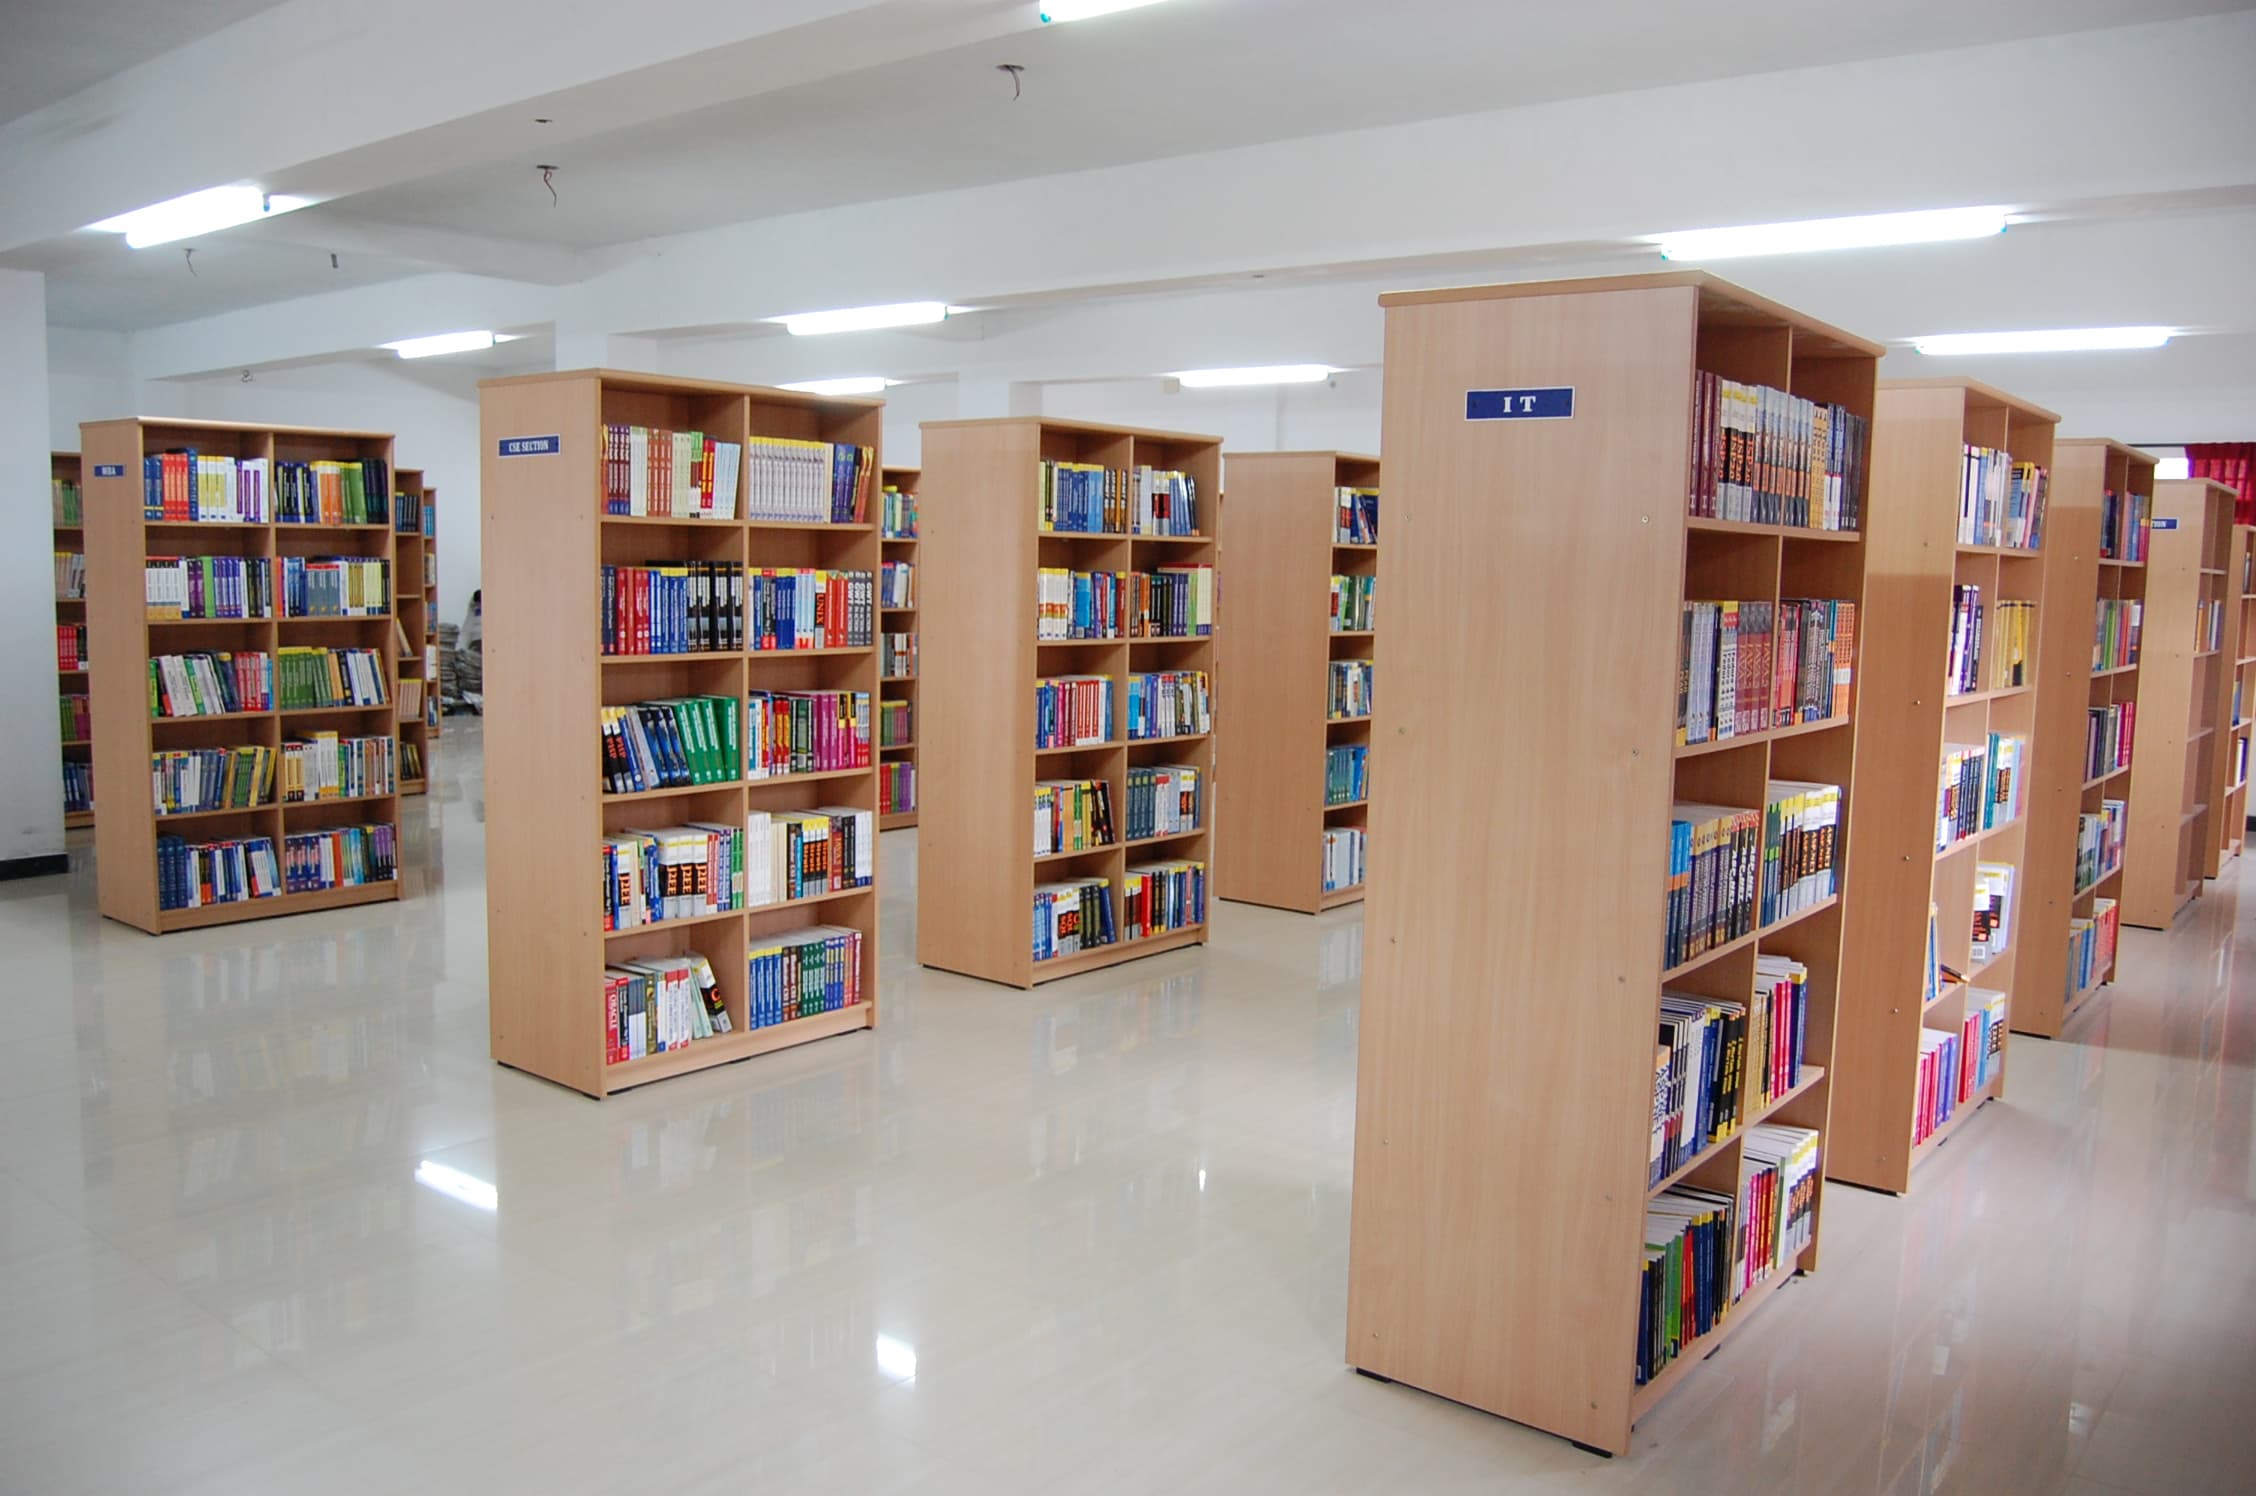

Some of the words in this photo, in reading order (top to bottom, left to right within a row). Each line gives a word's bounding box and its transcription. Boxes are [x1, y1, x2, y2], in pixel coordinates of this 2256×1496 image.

[508, 442, 520, 453] CSE
[521, 440, 549, 452] SECTION
[816, 594, 824, 624] UNIX
[606, 737, 617, 759] PHP
[616, 736, 627, 759] PHP
[1809, 832, 1817, 874] ASP.NET
[1824, 826, 1833, 867] ASP.NET
[619, 875, 631, 905] J2EE
[667, 866, 678, 896] J2EE
[681, 865, 692, 894] J2EE
[696, 864, 707, 893] J2EE
